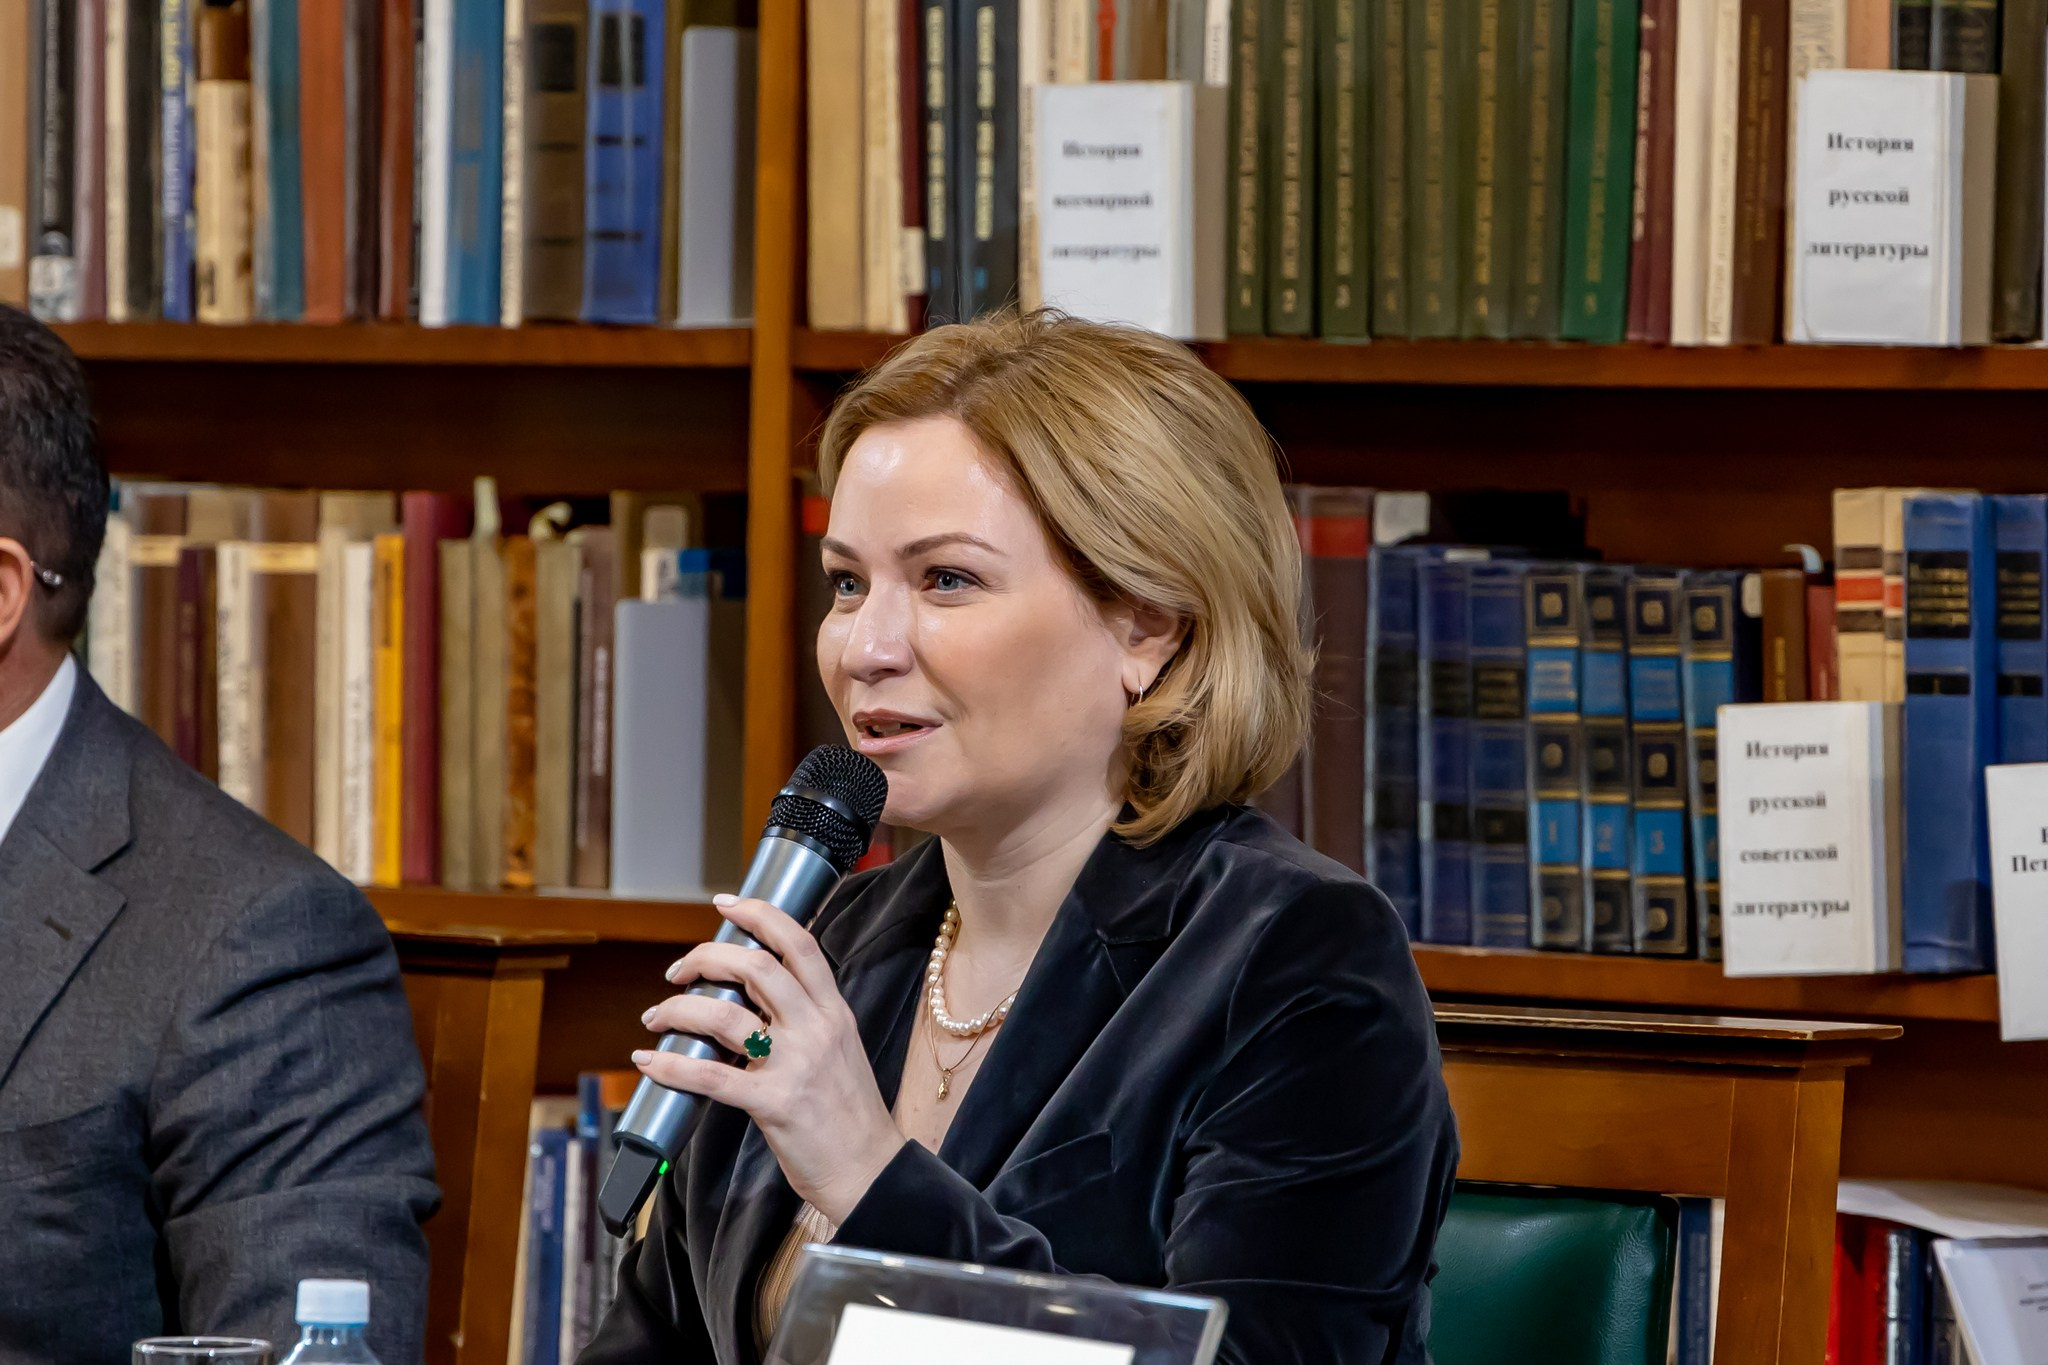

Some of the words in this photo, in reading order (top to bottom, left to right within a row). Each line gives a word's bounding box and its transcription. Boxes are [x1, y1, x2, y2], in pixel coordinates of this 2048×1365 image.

[1062, 140, 1142, 161] История
[1827, 132, 1914, 156] История
[1828, 188, 1910, 208] русской
[1806, 242, 1929, 261] литературы
[1745, 741, 1830, 762] История
[1749, 791, 1828, 816] русской
[1739, 843, 1839, 863] советской
[1732, 900, 1850, 919] литературы
